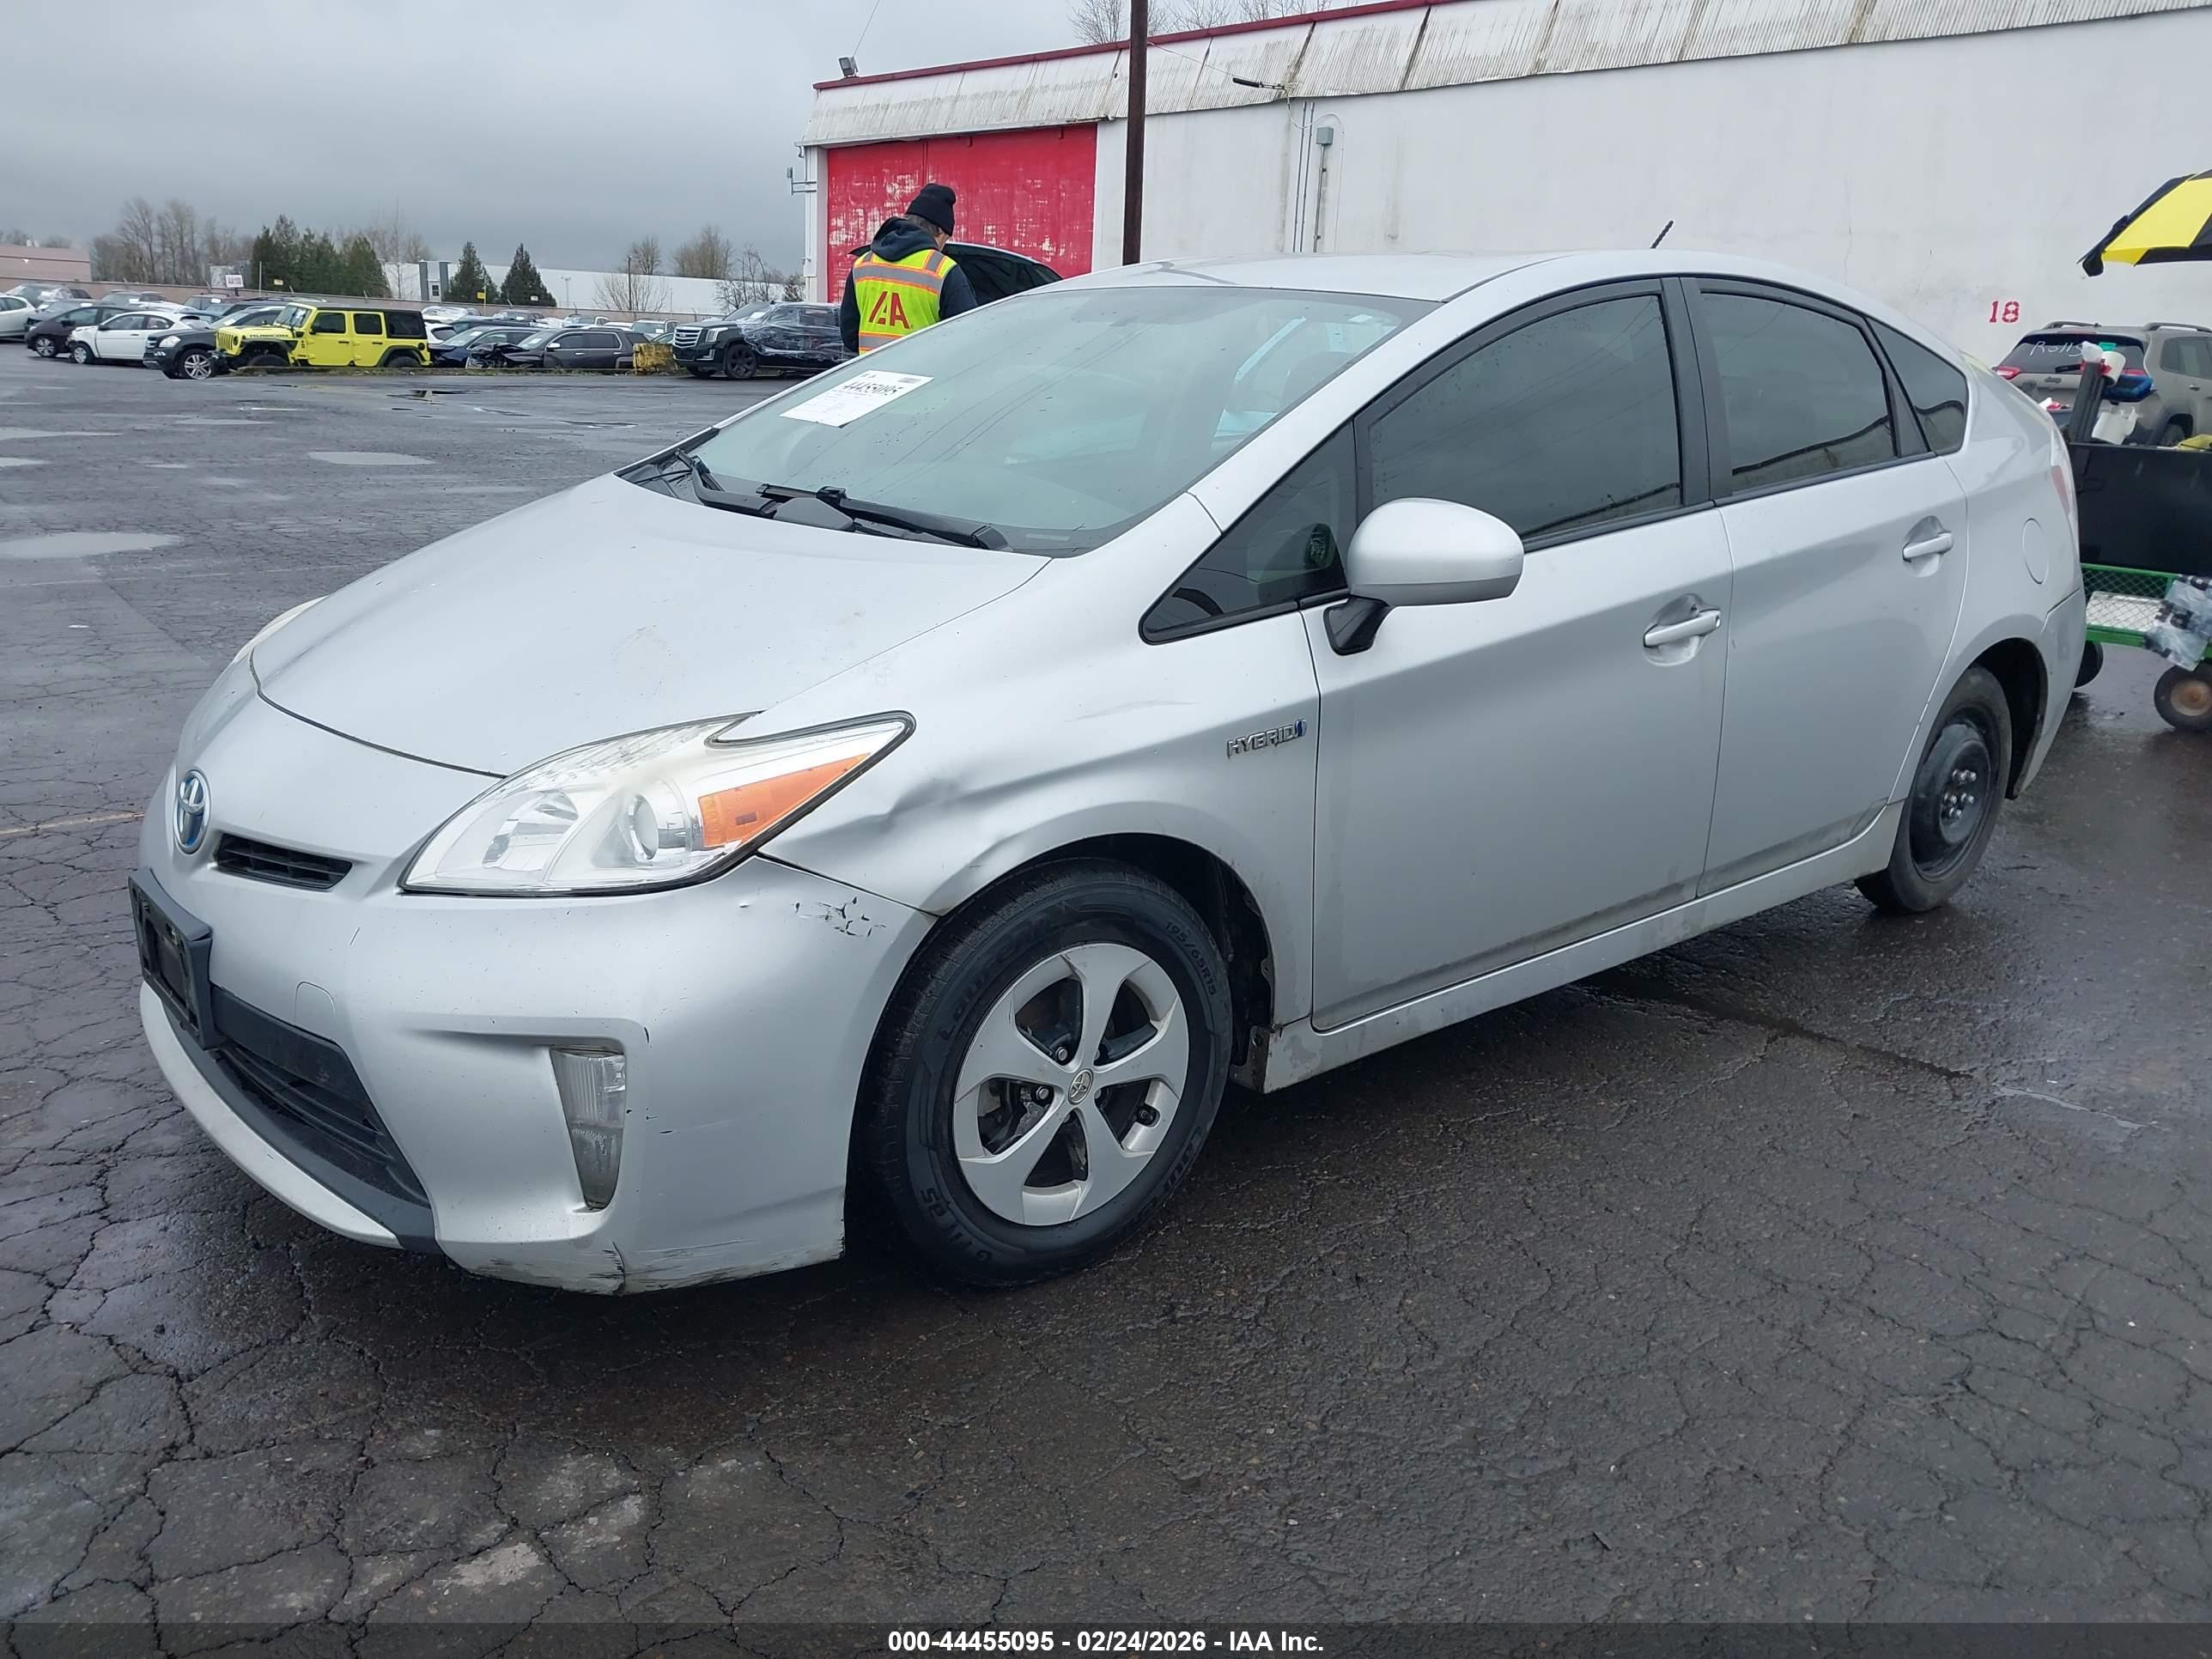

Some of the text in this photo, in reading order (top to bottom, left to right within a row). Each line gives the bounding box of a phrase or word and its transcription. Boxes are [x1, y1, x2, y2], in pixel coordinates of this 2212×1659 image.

[1989, 301, 2020, 323] 18
[1227, 725, 1297, 759] HYBRID
[1166, 921, 1217, 995] 195/65R15
